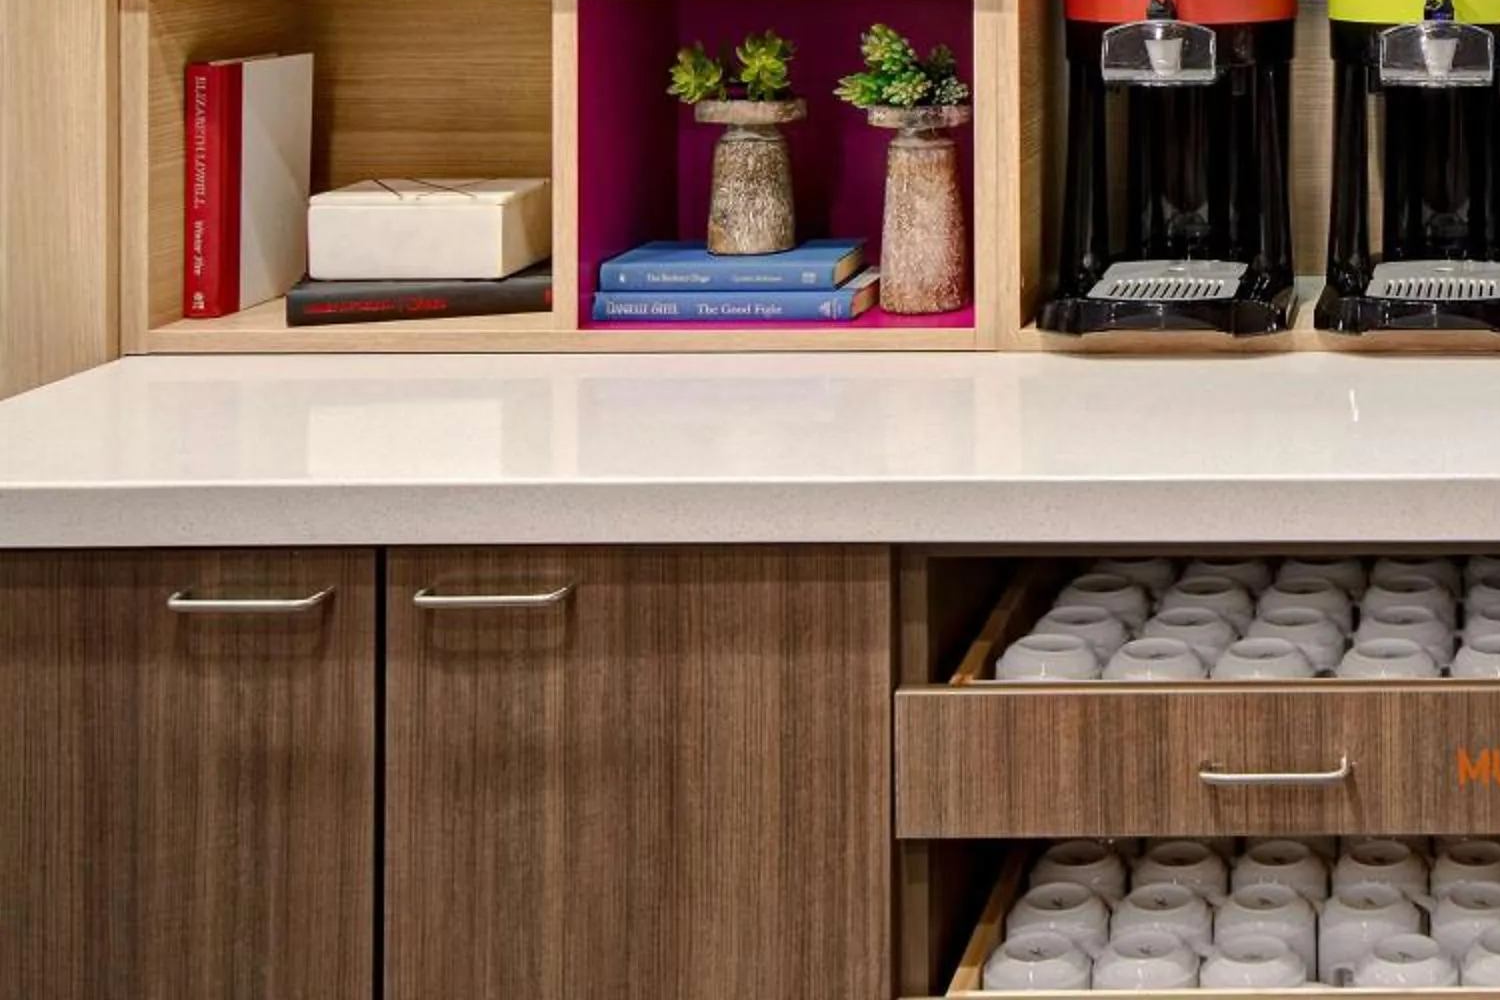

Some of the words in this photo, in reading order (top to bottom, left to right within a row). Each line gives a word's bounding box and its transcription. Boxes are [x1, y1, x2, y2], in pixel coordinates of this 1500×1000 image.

[193, 75, 206, 152] ELIZABETH
[193, 153, 206, 209] LOWELL
[698, 303, 718, 315] The
[721, 304, 751, 315] Good
